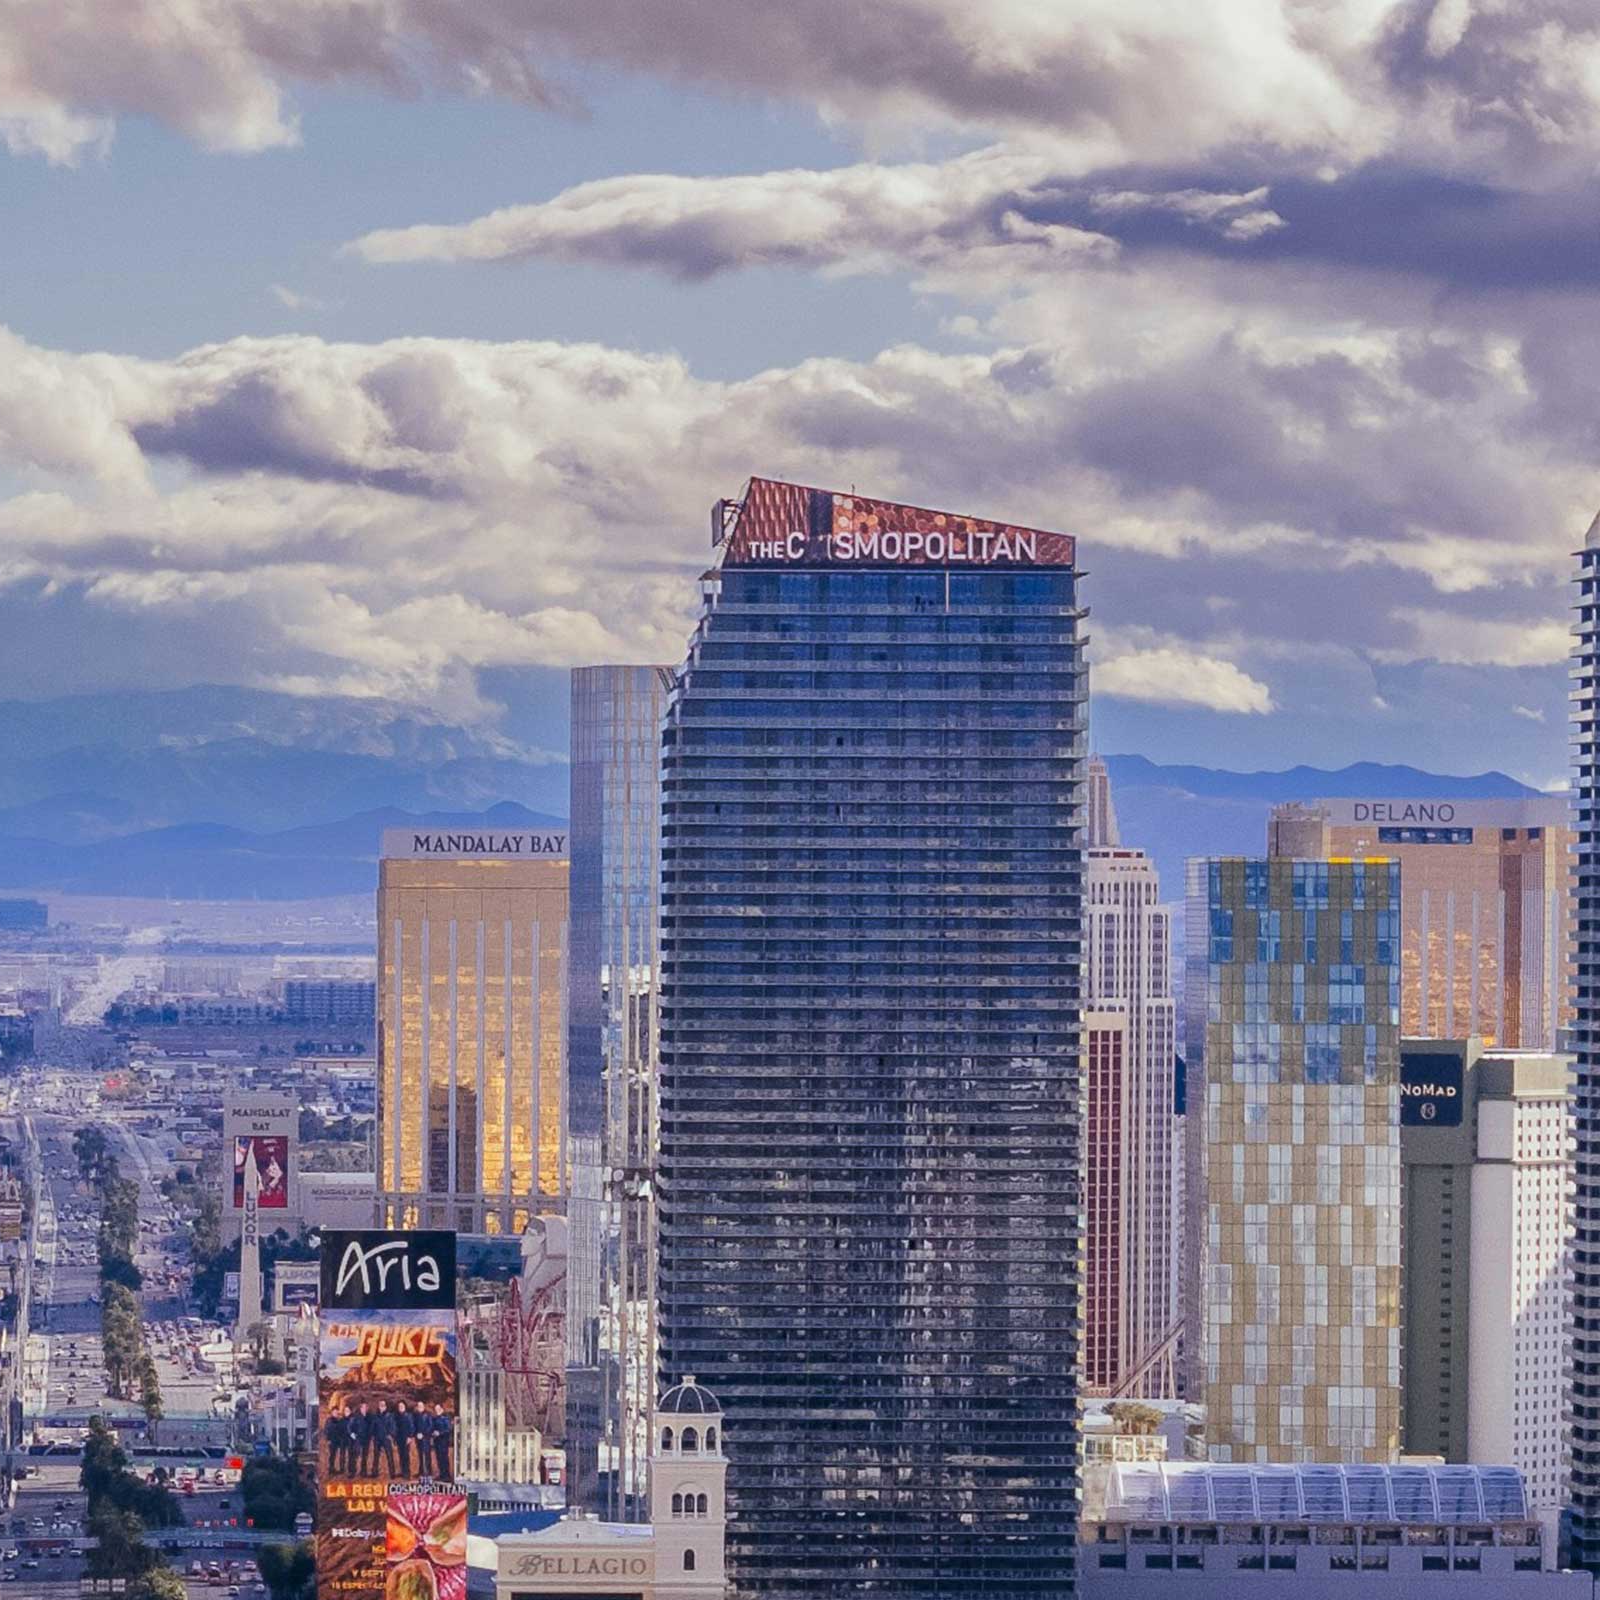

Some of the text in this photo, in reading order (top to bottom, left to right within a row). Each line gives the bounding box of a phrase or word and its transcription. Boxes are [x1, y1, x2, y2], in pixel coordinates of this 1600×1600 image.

[748, 531, 1036, 562] THE CSMOPOLITAN
[1354, 803, 1455, 824] DELANO
[413, 835, 567, 854] MANDALAY BAY
[245, 1191, 257, 1247] LUXOR
[335, 1241, 441, 1297] Aria
[388, 1482, 468, 1496] COSMOPOLITAN
[508, 1554, 648, 1576] BELLAGIO
